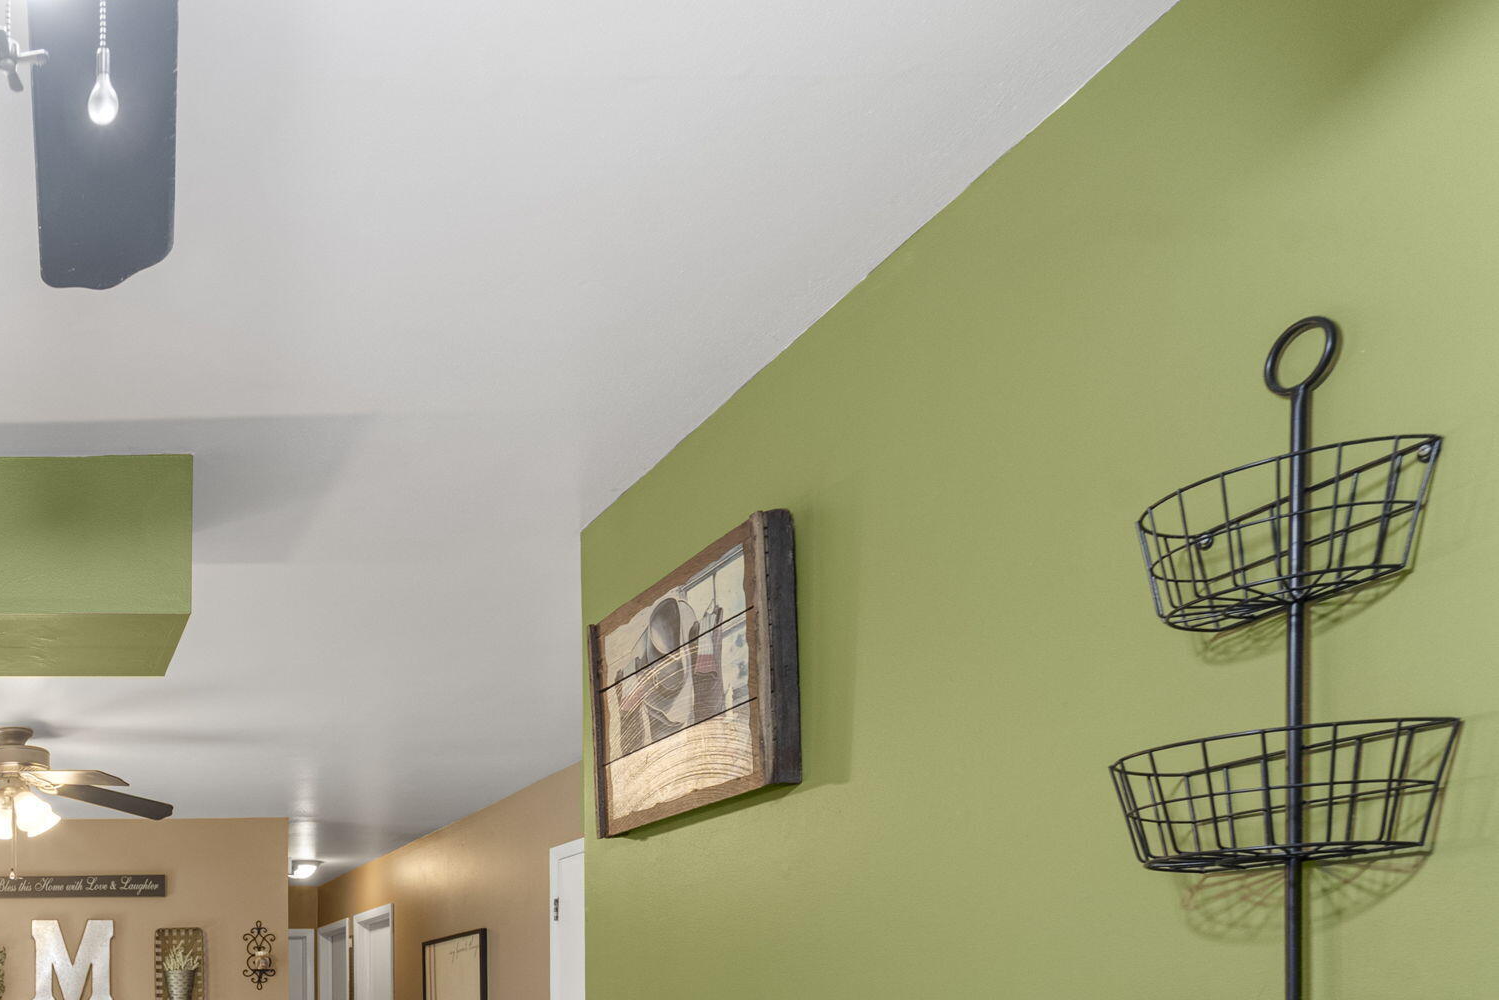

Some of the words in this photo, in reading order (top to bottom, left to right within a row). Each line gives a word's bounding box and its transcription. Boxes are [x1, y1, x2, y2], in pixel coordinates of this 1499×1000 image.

[18, 879, 32, 892] this
[34, 877, 64, 892] Home
[65, 879, 84, 892] with
[85, 876, 108, 892] Love
[109, 881, 117, 890] &
[119, 876, 160, 896] Laughter
